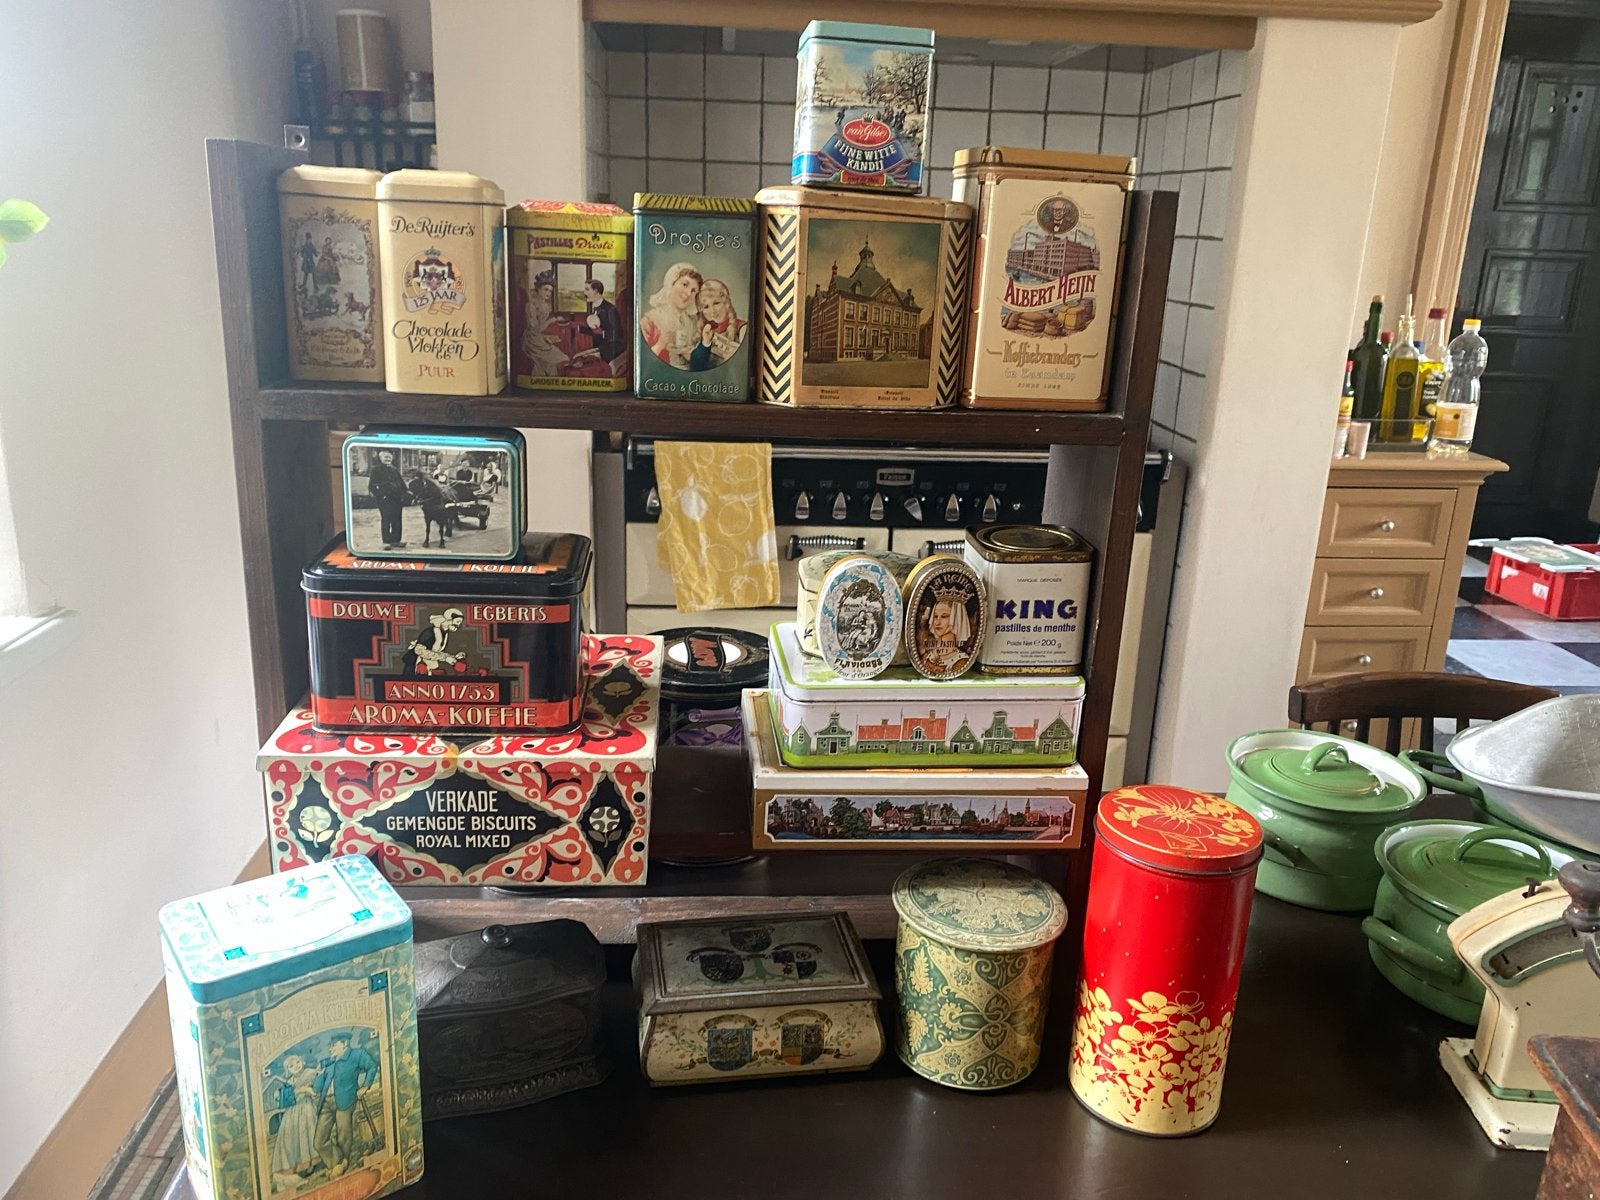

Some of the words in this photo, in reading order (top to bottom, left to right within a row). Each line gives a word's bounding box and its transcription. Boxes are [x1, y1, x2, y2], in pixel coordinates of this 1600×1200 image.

[834, 140, 863, 160] FIJNE
[864, 144, 897, 160] WITTE
[846, 158, 884, 171] KANDIJ
[390, 215, 414, 233] De
[528, 233, 574, 254] PASTILLES
[648, 223, 742, 254] Droste's
[430, 290, 457, 302] JAAR
[1003, 276, 1055, 307] ALBERT
[1057, 274, 1097, 305] HEIJN
[393, 319, 473, 340] Chocolade
[407, 336, 480, 362] Vlokken
[418, 364, 456, 378] PUUR
[644, 378, 676, 392] Cacao
[688, 379, 740, 395] Chocolade
[332, 602, 408, 619] DOUWE
[473, 605, 548, 622] EGBERTS
[995, 598, 1078, 620] KING
[995, 623, 1031, 634] pastilles
[1044, 622, 1076, 633] menthe
[1041, 638, 1057, 647] 200
[388, 683, 445, 701] ANNO
[450, 684, 496, 701] 1753
[425, 789, 498, 813] VERKADE
[386, 815, 467, 832] GEMENGDE
[471, 815, 537, 832] BISCUITS
[416, 834, 461, 849] ROYAL
[465, 834, 511, 849] MIXED
